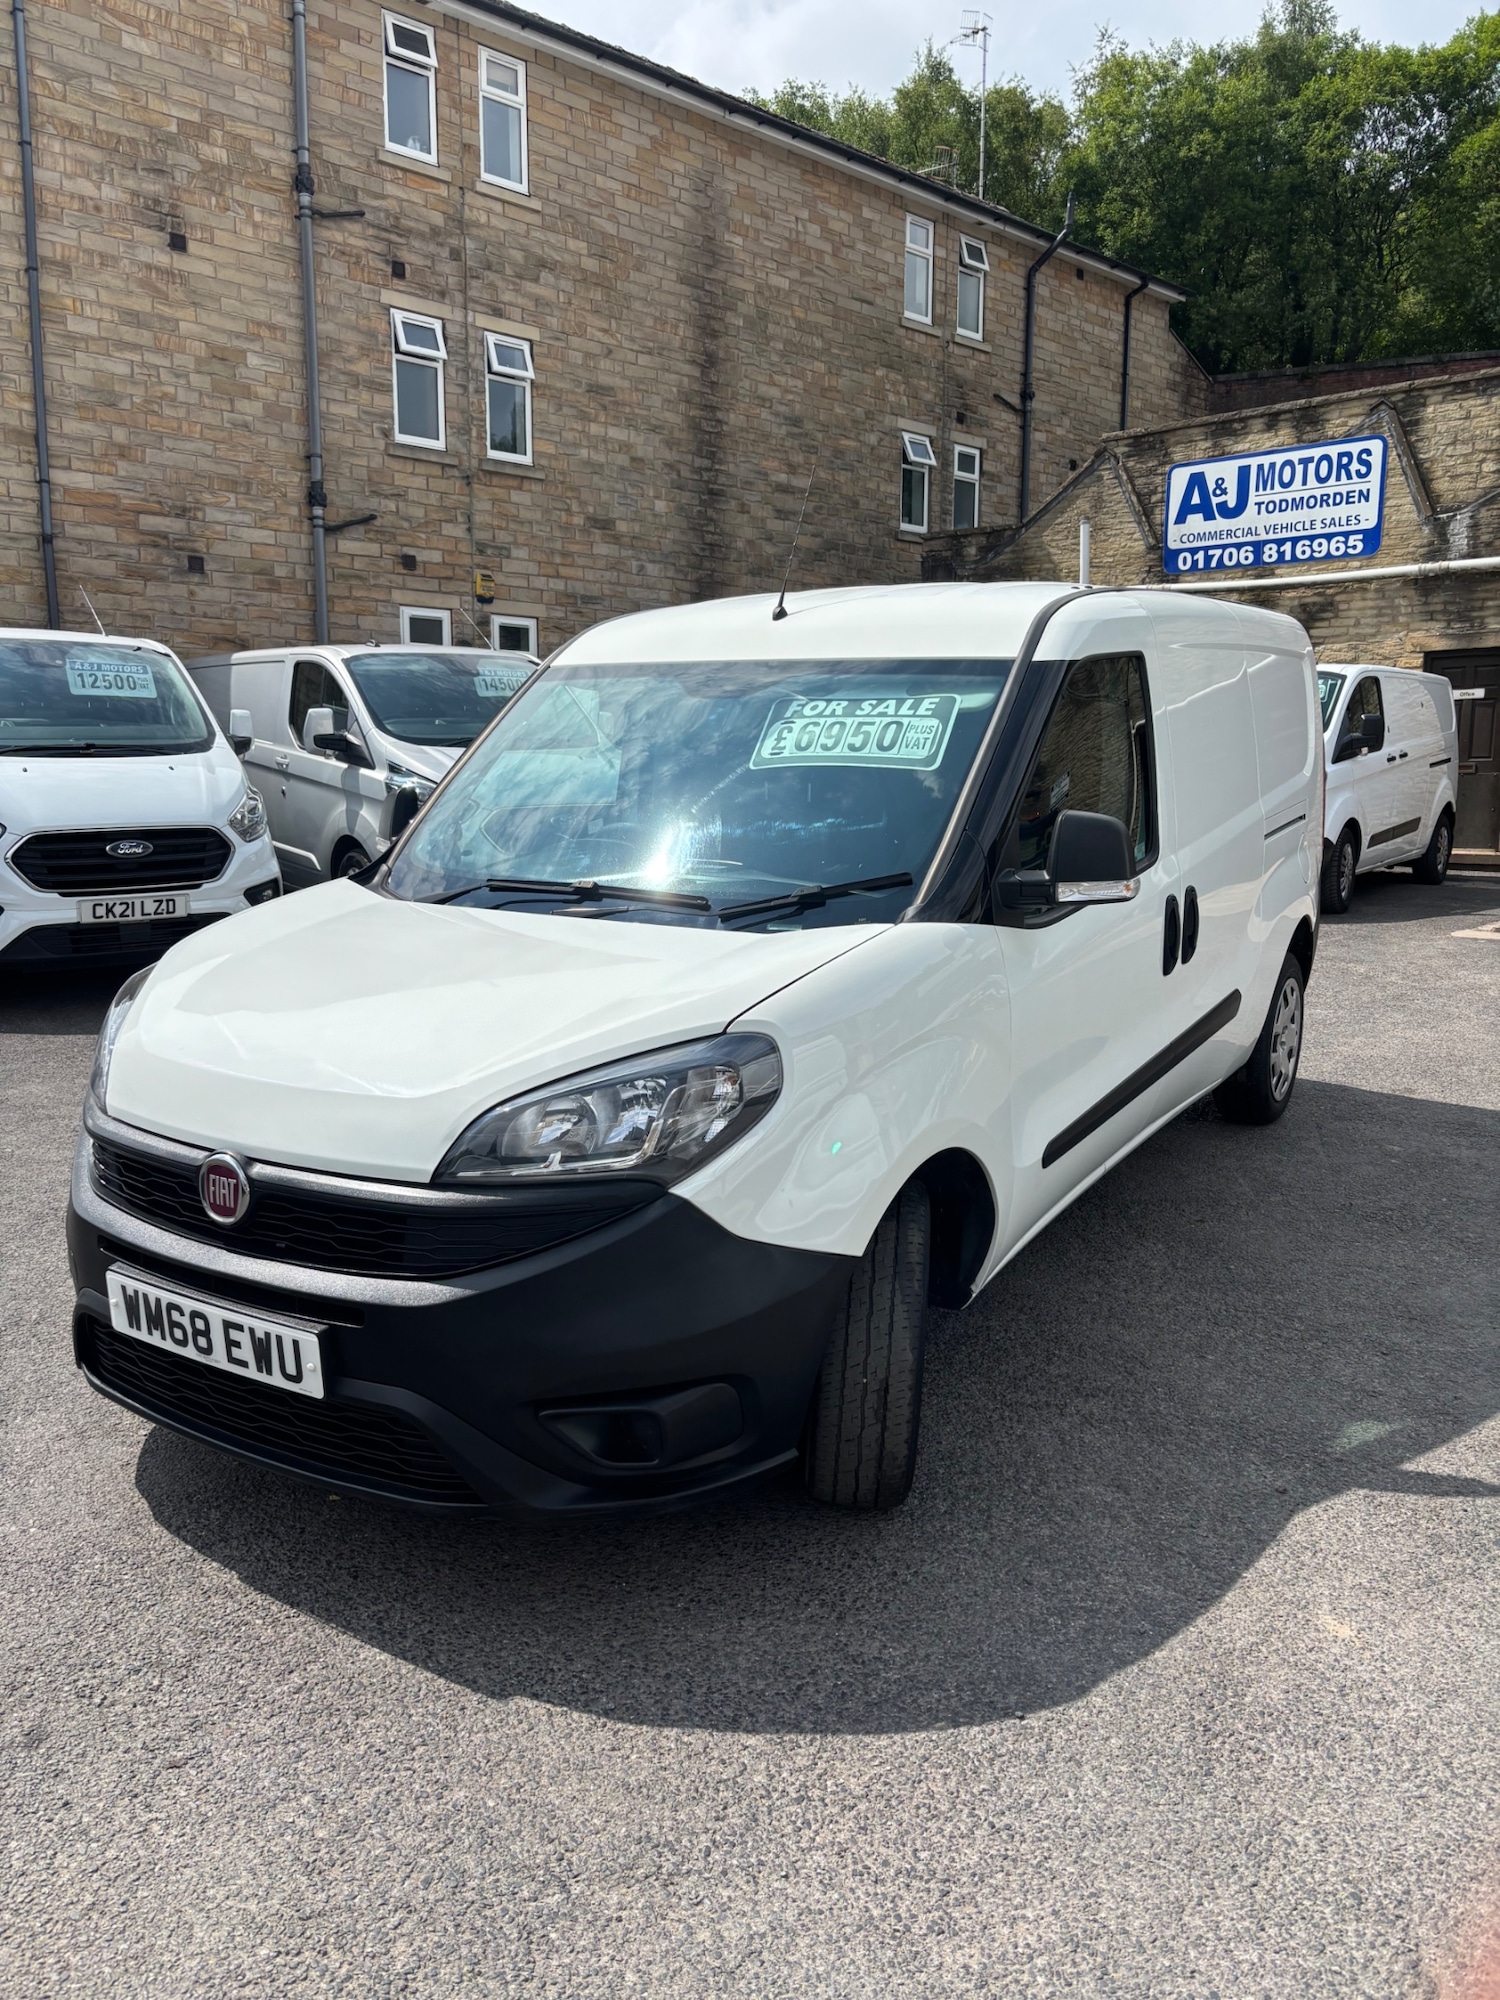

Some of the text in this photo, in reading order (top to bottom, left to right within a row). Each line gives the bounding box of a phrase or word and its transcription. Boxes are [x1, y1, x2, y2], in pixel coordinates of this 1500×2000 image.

[1255, 448, 1373, 493] MOTORS
[1173, 464, 1252, 526] A&J
[1254, 488, 1371, 516] TODMORDEN
[1179, 525, 1261, 545] COMMERCIAL
[1263, 519, 1317, 535] VEHICLE
[1320, 514, 1361, 530] SALES
[1177, 534, 1364, 571] 01706 816965
[101, 664, 144, 674] MOTORS
[77, 673, 137, 690] 12500
[784, 698, 940, 717] FOR SALE
[907, 724, 935, 734] PLUS
[904, 736, 930, 750] VAT
[117, 842, 144, 854] Ford
[92, 898, 176, 919] CK21 LZD
[209, 1174, 237, 1208] FIAT
[121, 1284, 303, 1384] WM68 EWU
